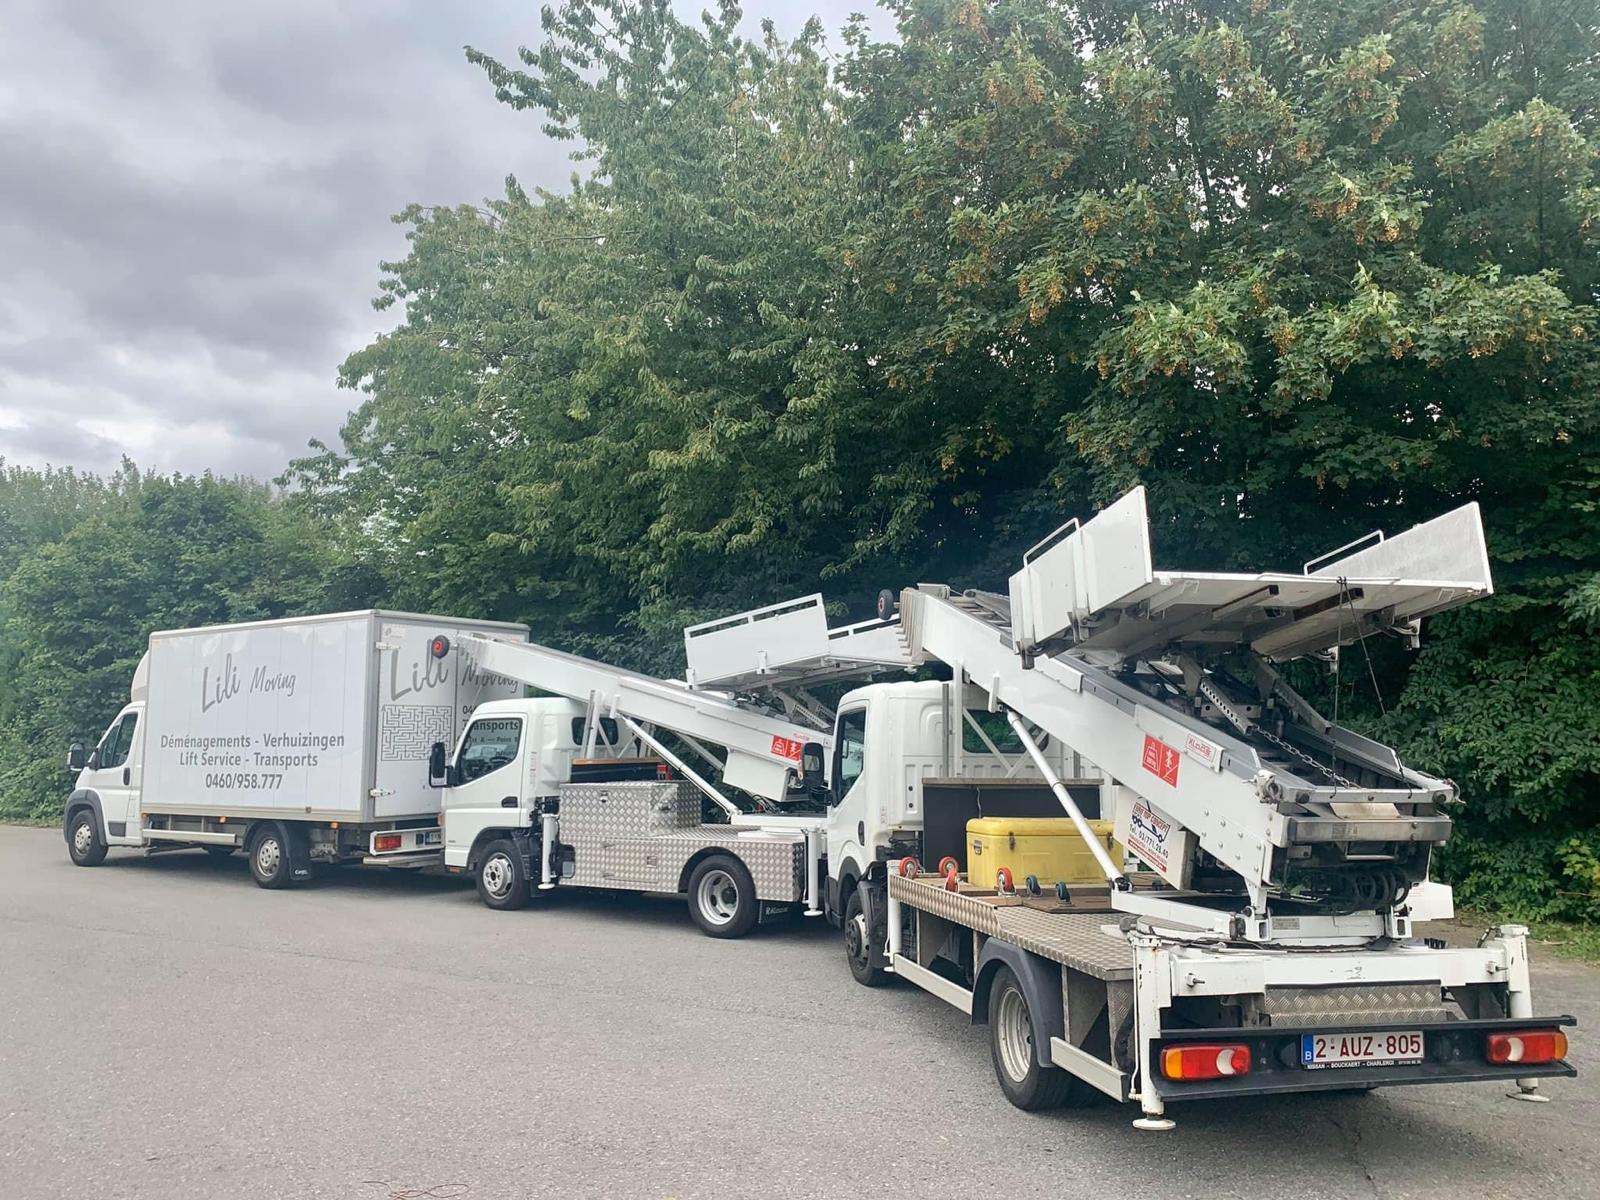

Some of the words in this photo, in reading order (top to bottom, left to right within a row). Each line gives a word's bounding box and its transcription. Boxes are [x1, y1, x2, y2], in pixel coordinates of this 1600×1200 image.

[390, 638, 449, 701] Lili
[202, 653, 240, 713] Lili
[250, 665, 296, 697] Moving
[160, 734, 251, 752] Déménagements
[263, 732, 345, 751] Verhuizingen
[180, 752, 198, 766] Lift
[201, 751, 241, 766] Service
[254, 751, 318, 770] Transports
[205, 773, 283, 790] 0460/958.777
[1305, 1051, 1312, 1061] B
